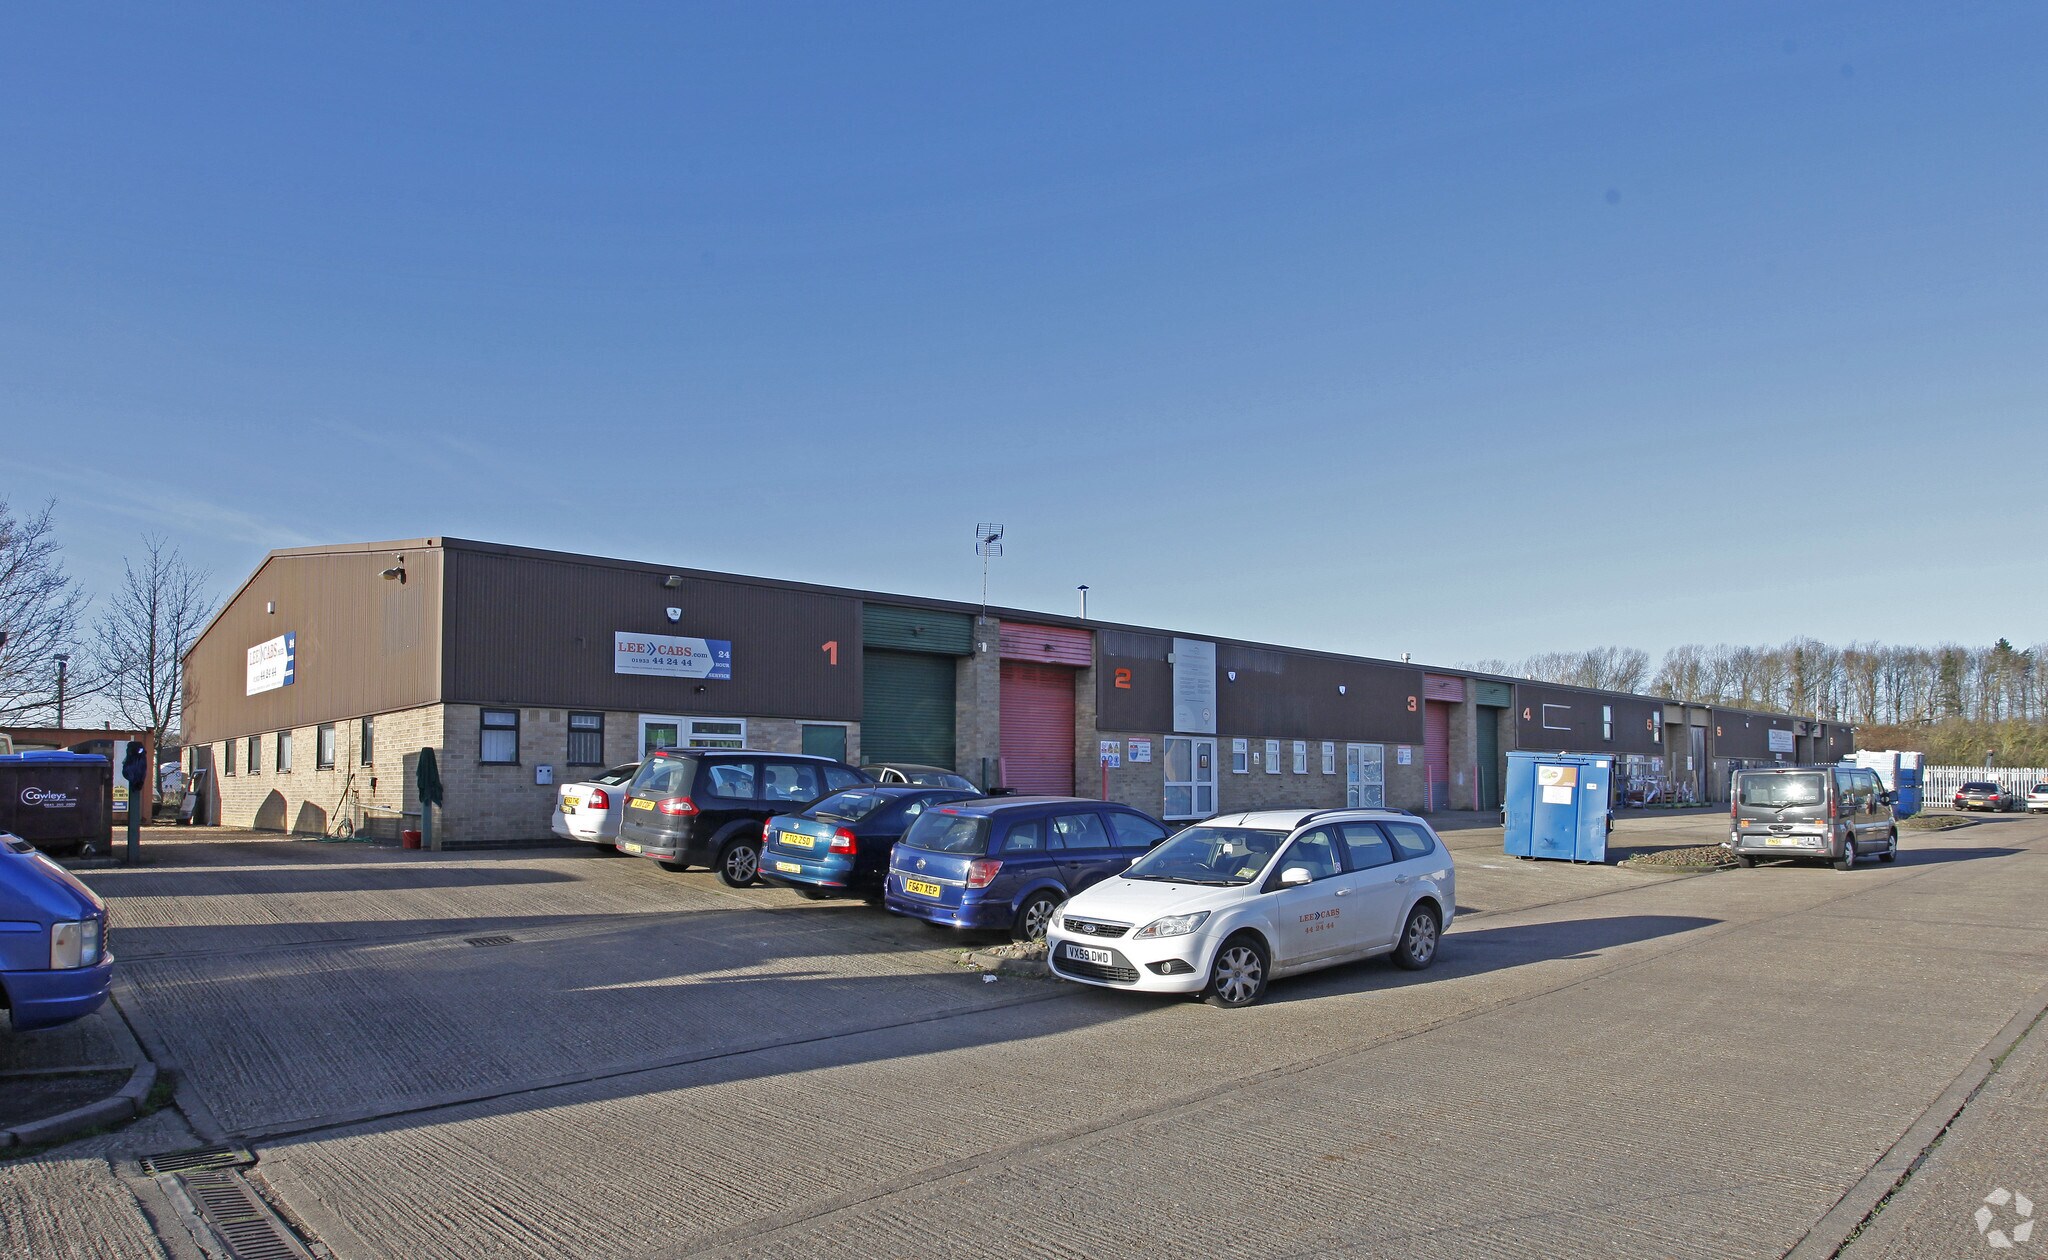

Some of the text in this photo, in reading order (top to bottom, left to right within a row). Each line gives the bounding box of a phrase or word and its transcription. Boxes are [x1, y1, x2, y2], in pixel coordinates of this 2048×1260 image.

[618, 642, 645, 653] LEE
[718, 650, 730, 658] 24
[822, 641, 838, 665] 1
[666, 658, 678, 666] 24
[681, 658, 692, 666] 44
[1115, 668, 1131, 688] 2
[1407, 696, 1416, 712] 3
[1523, 708, 1531, 721] 4
[1646, 719, 1652, 730] 5
[26, 790, 66, 801] Cawleys
[1299, 908, 1340, 922] LEE CABS
[1069, 947, 1089, 960] VX59
